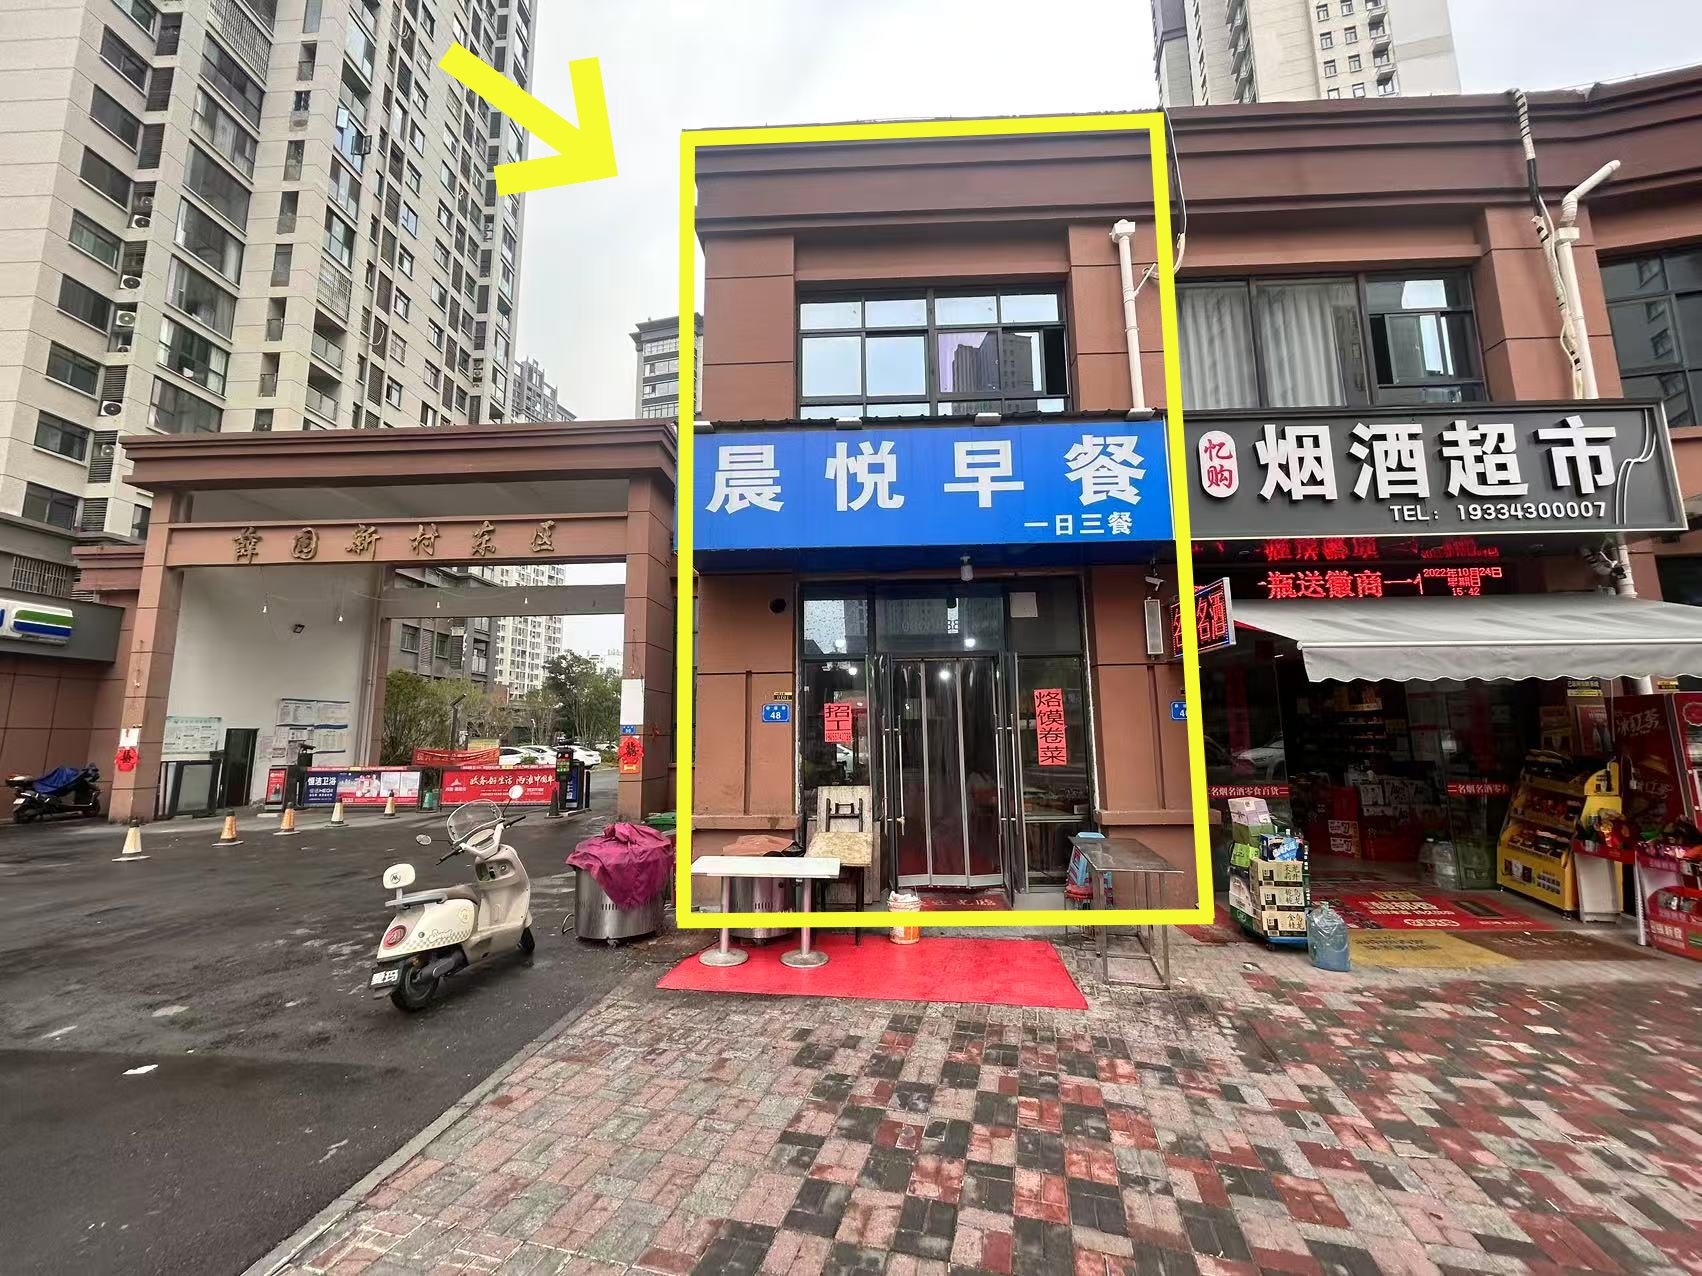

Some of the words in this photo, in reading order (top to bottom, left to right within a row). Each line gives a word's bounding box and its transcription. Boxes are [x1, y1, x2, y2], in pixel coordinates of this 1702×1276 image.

[1203, 438, 1234, 490] 忆购
[1256, 415, 1617, 501] 烟酒超市
[704, 434, 1148, 515] 晨悦早餐
[1023, 511, 1134, 536] 一日三餐
[1389, 504, 1440, 521] TEL:
[1457, 502, 1607, 521] 19334300007
[1423, 567, 1503, 578] 2022年10月24日
[770, 711, 782, 720] 48
[825, 705, 851, 731] 招工
[1035, 691, 1066, 764] 烙馍卷菜
[307, 776, 337, 786] 恒洁卫浴
[1211, 786, 1280, 796] 名烟名酒零食百货
